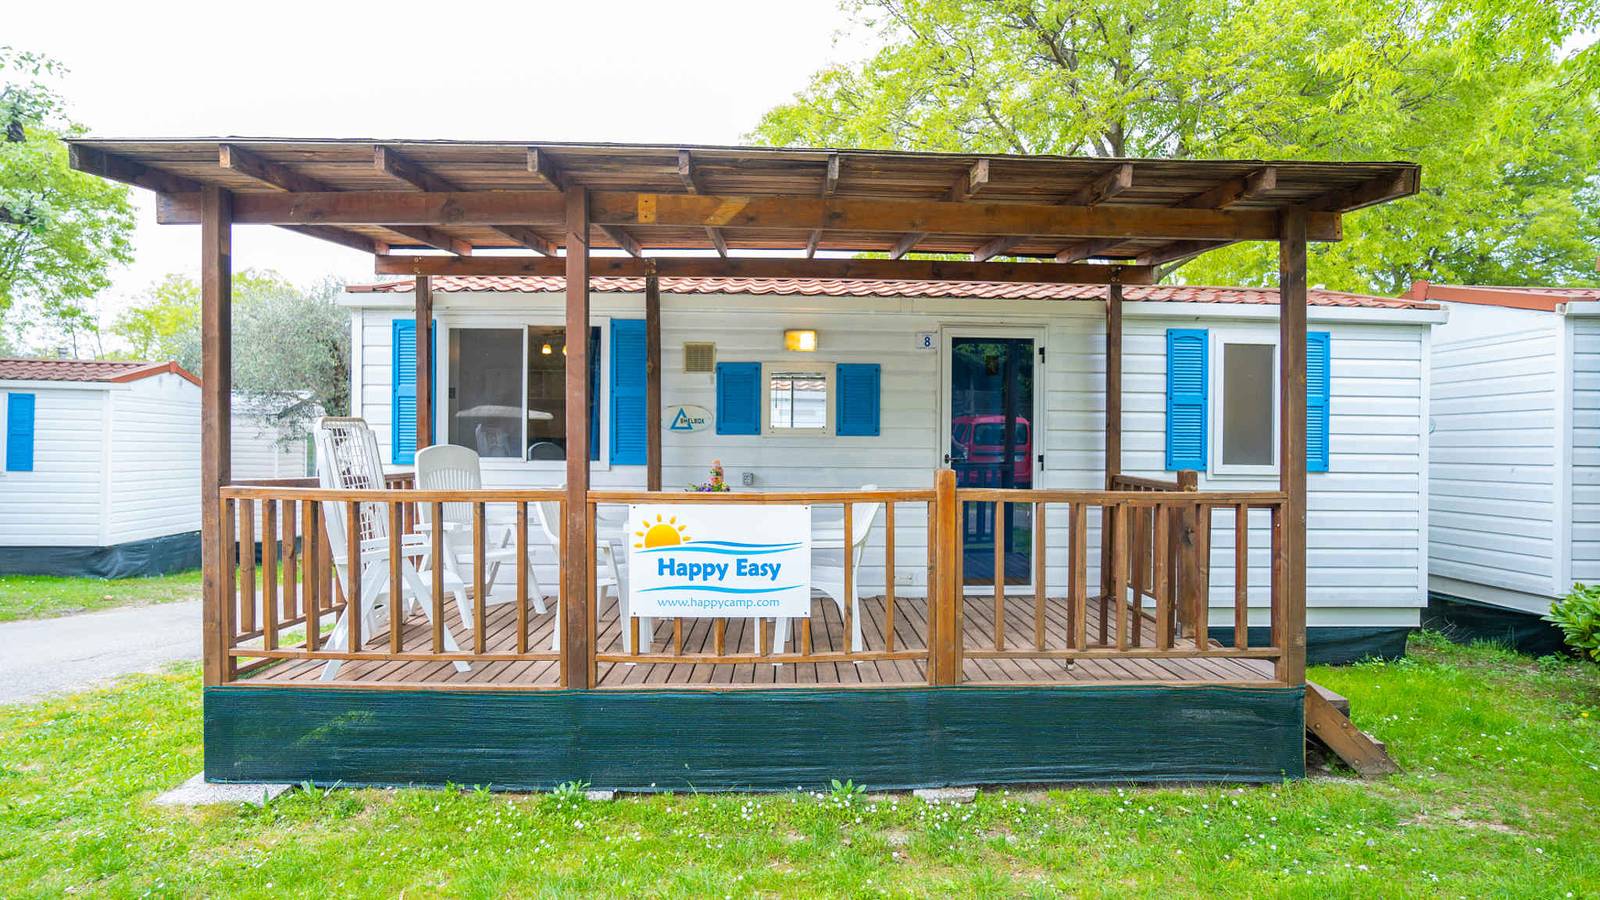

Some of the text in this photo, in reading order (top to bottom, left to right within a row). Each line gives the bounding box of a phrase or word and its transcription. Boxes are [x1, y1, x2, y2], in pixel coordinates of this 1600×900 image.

[924, 336, 931, 347] 8
[657, 557, 782, 582] Happy Easy
[657, 597, 780, 609] www.happycamp.com
